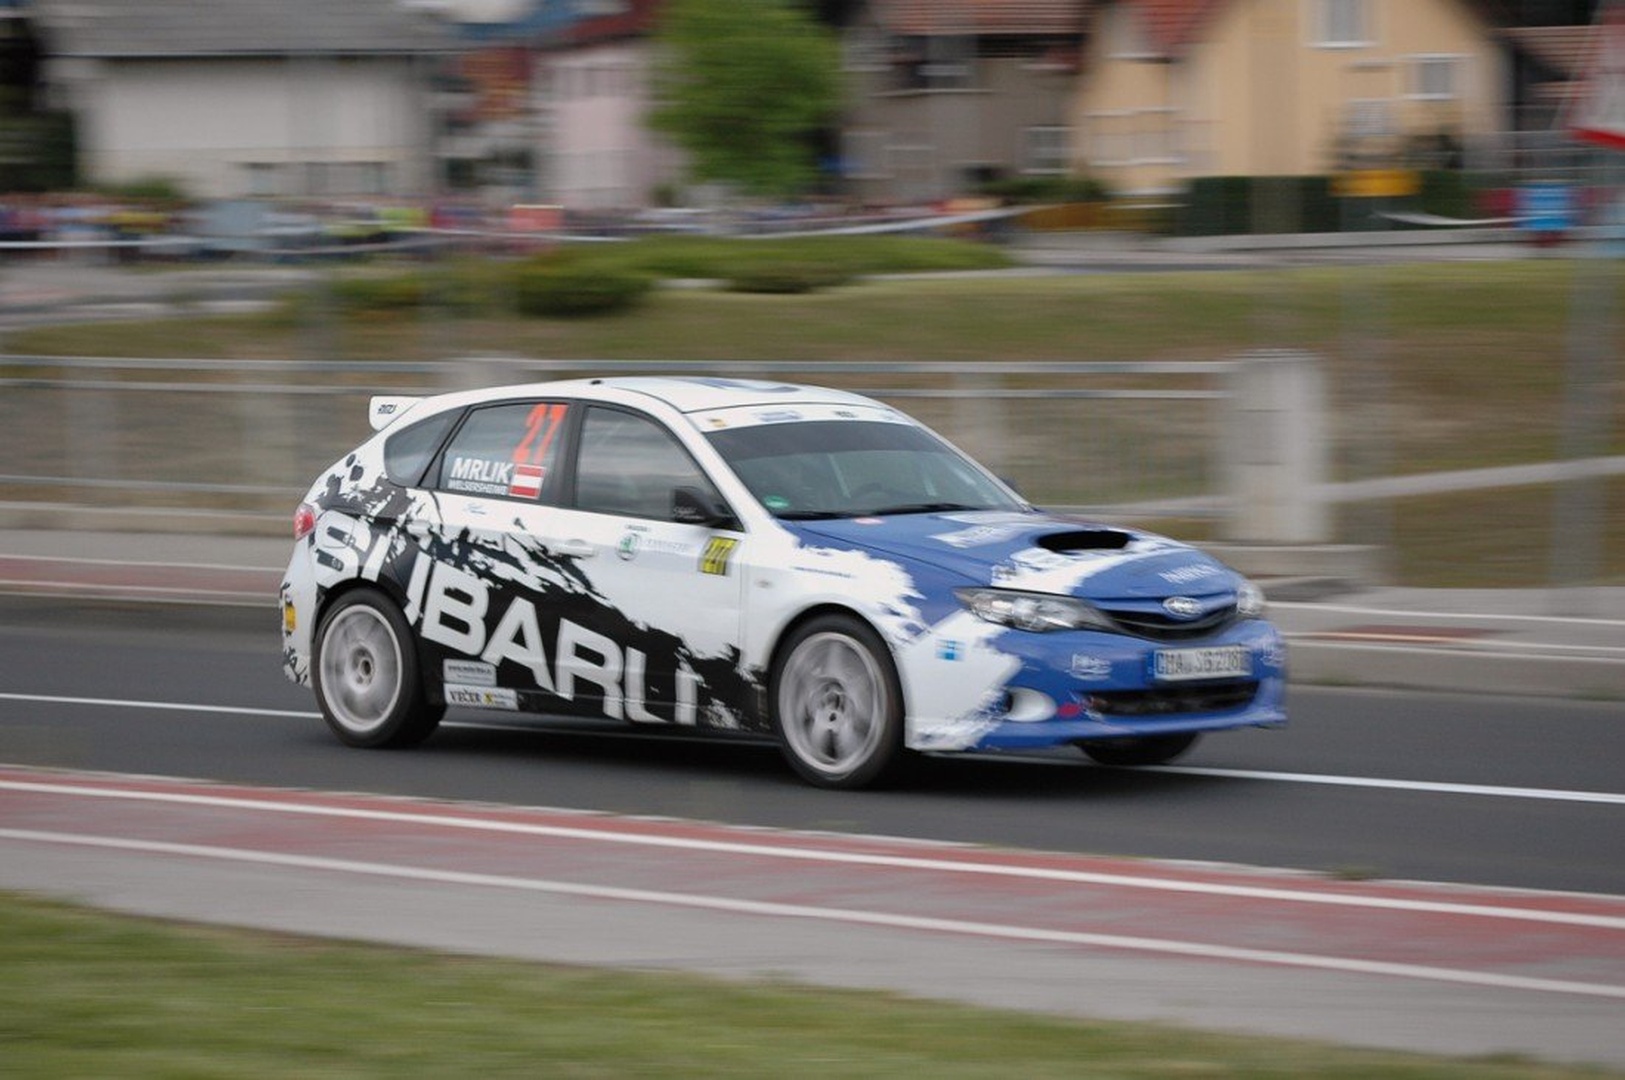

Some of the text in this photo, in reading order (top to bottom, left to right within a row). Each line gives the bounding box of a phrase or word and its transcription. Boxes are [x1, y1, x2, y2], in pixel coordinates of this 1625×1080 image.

[513, 403, 569, 465] 27
[450, 457, 514, 484] MRLIK
[314, 509, 698, 726] SUBARU
